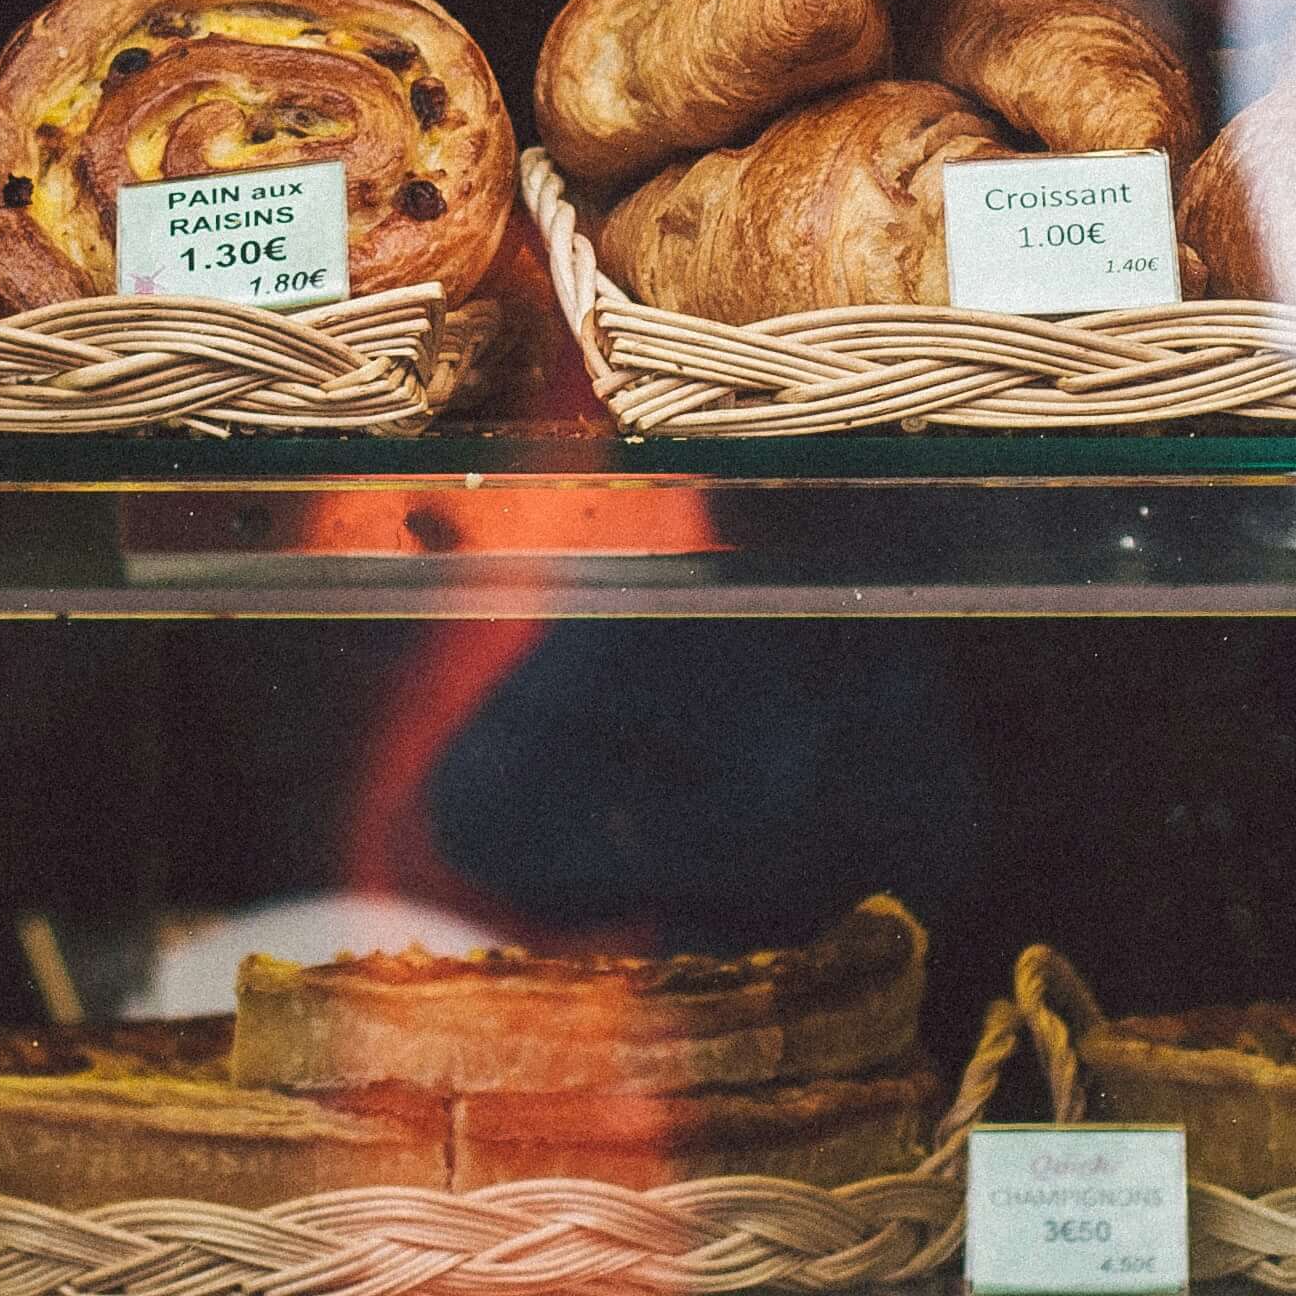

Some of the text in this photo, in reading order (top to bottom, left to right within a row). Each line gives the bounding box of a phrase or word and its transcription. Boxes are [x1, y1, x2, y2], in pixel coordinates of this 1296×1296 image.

[168, 182, 304, 209] PAIN aux
[985, 183, 1132, 211] Croissant
[169, 206, 296, 236] RAISINS
[1018, 222, 1107, 249] 1.00€
[180, 236, 288, 272] 1.30€
[1105, 256, 1160, 274] 1.40€
[249, 268, 328, 296] 1.80€
[990, 1187, 1164, 1206] CHAMPIGNONS
[1043, 1219, 1112, 1244] 3€50
